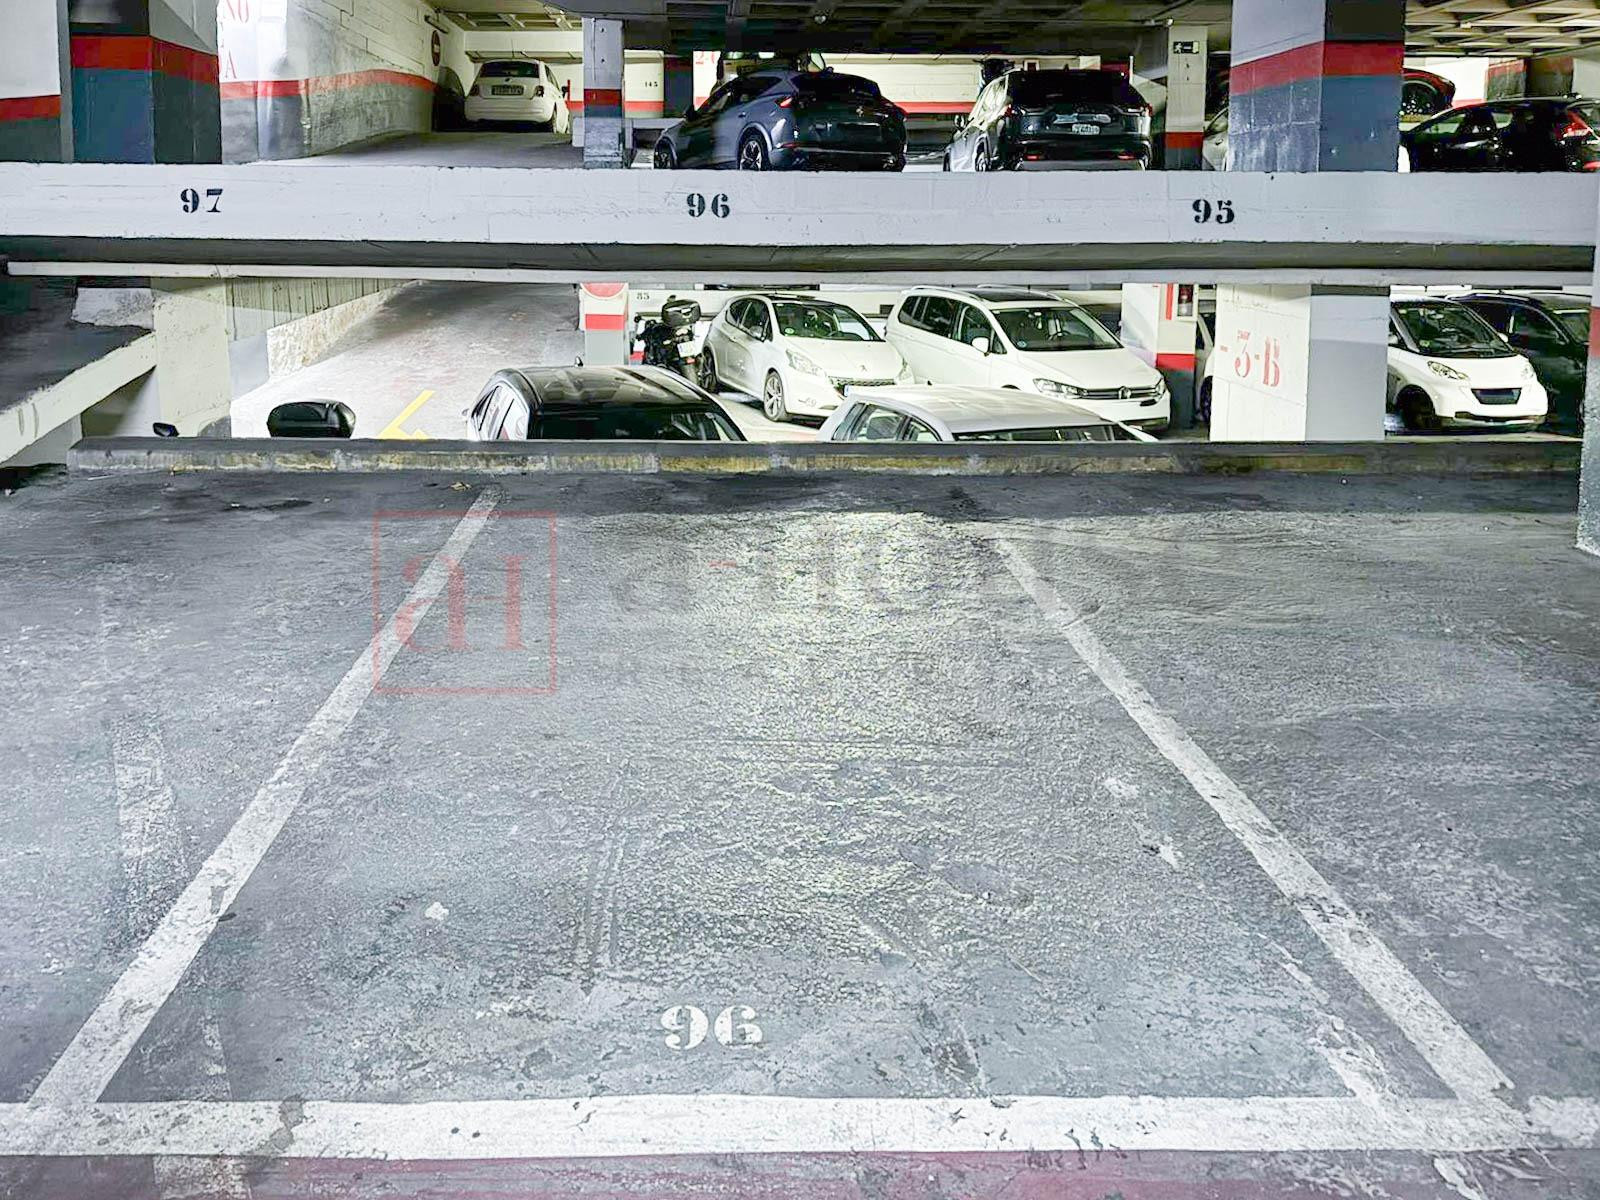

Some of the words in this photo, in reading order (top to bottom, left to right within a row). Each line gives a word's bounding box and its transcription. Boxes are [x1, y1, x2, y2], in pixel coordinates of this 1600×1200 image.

[180, 188, 223, 214] 97
[686, 193, 730, 219] 96
[1192, 198, 1235, 225] 95
[661, 1004, 763, 1050] 96
